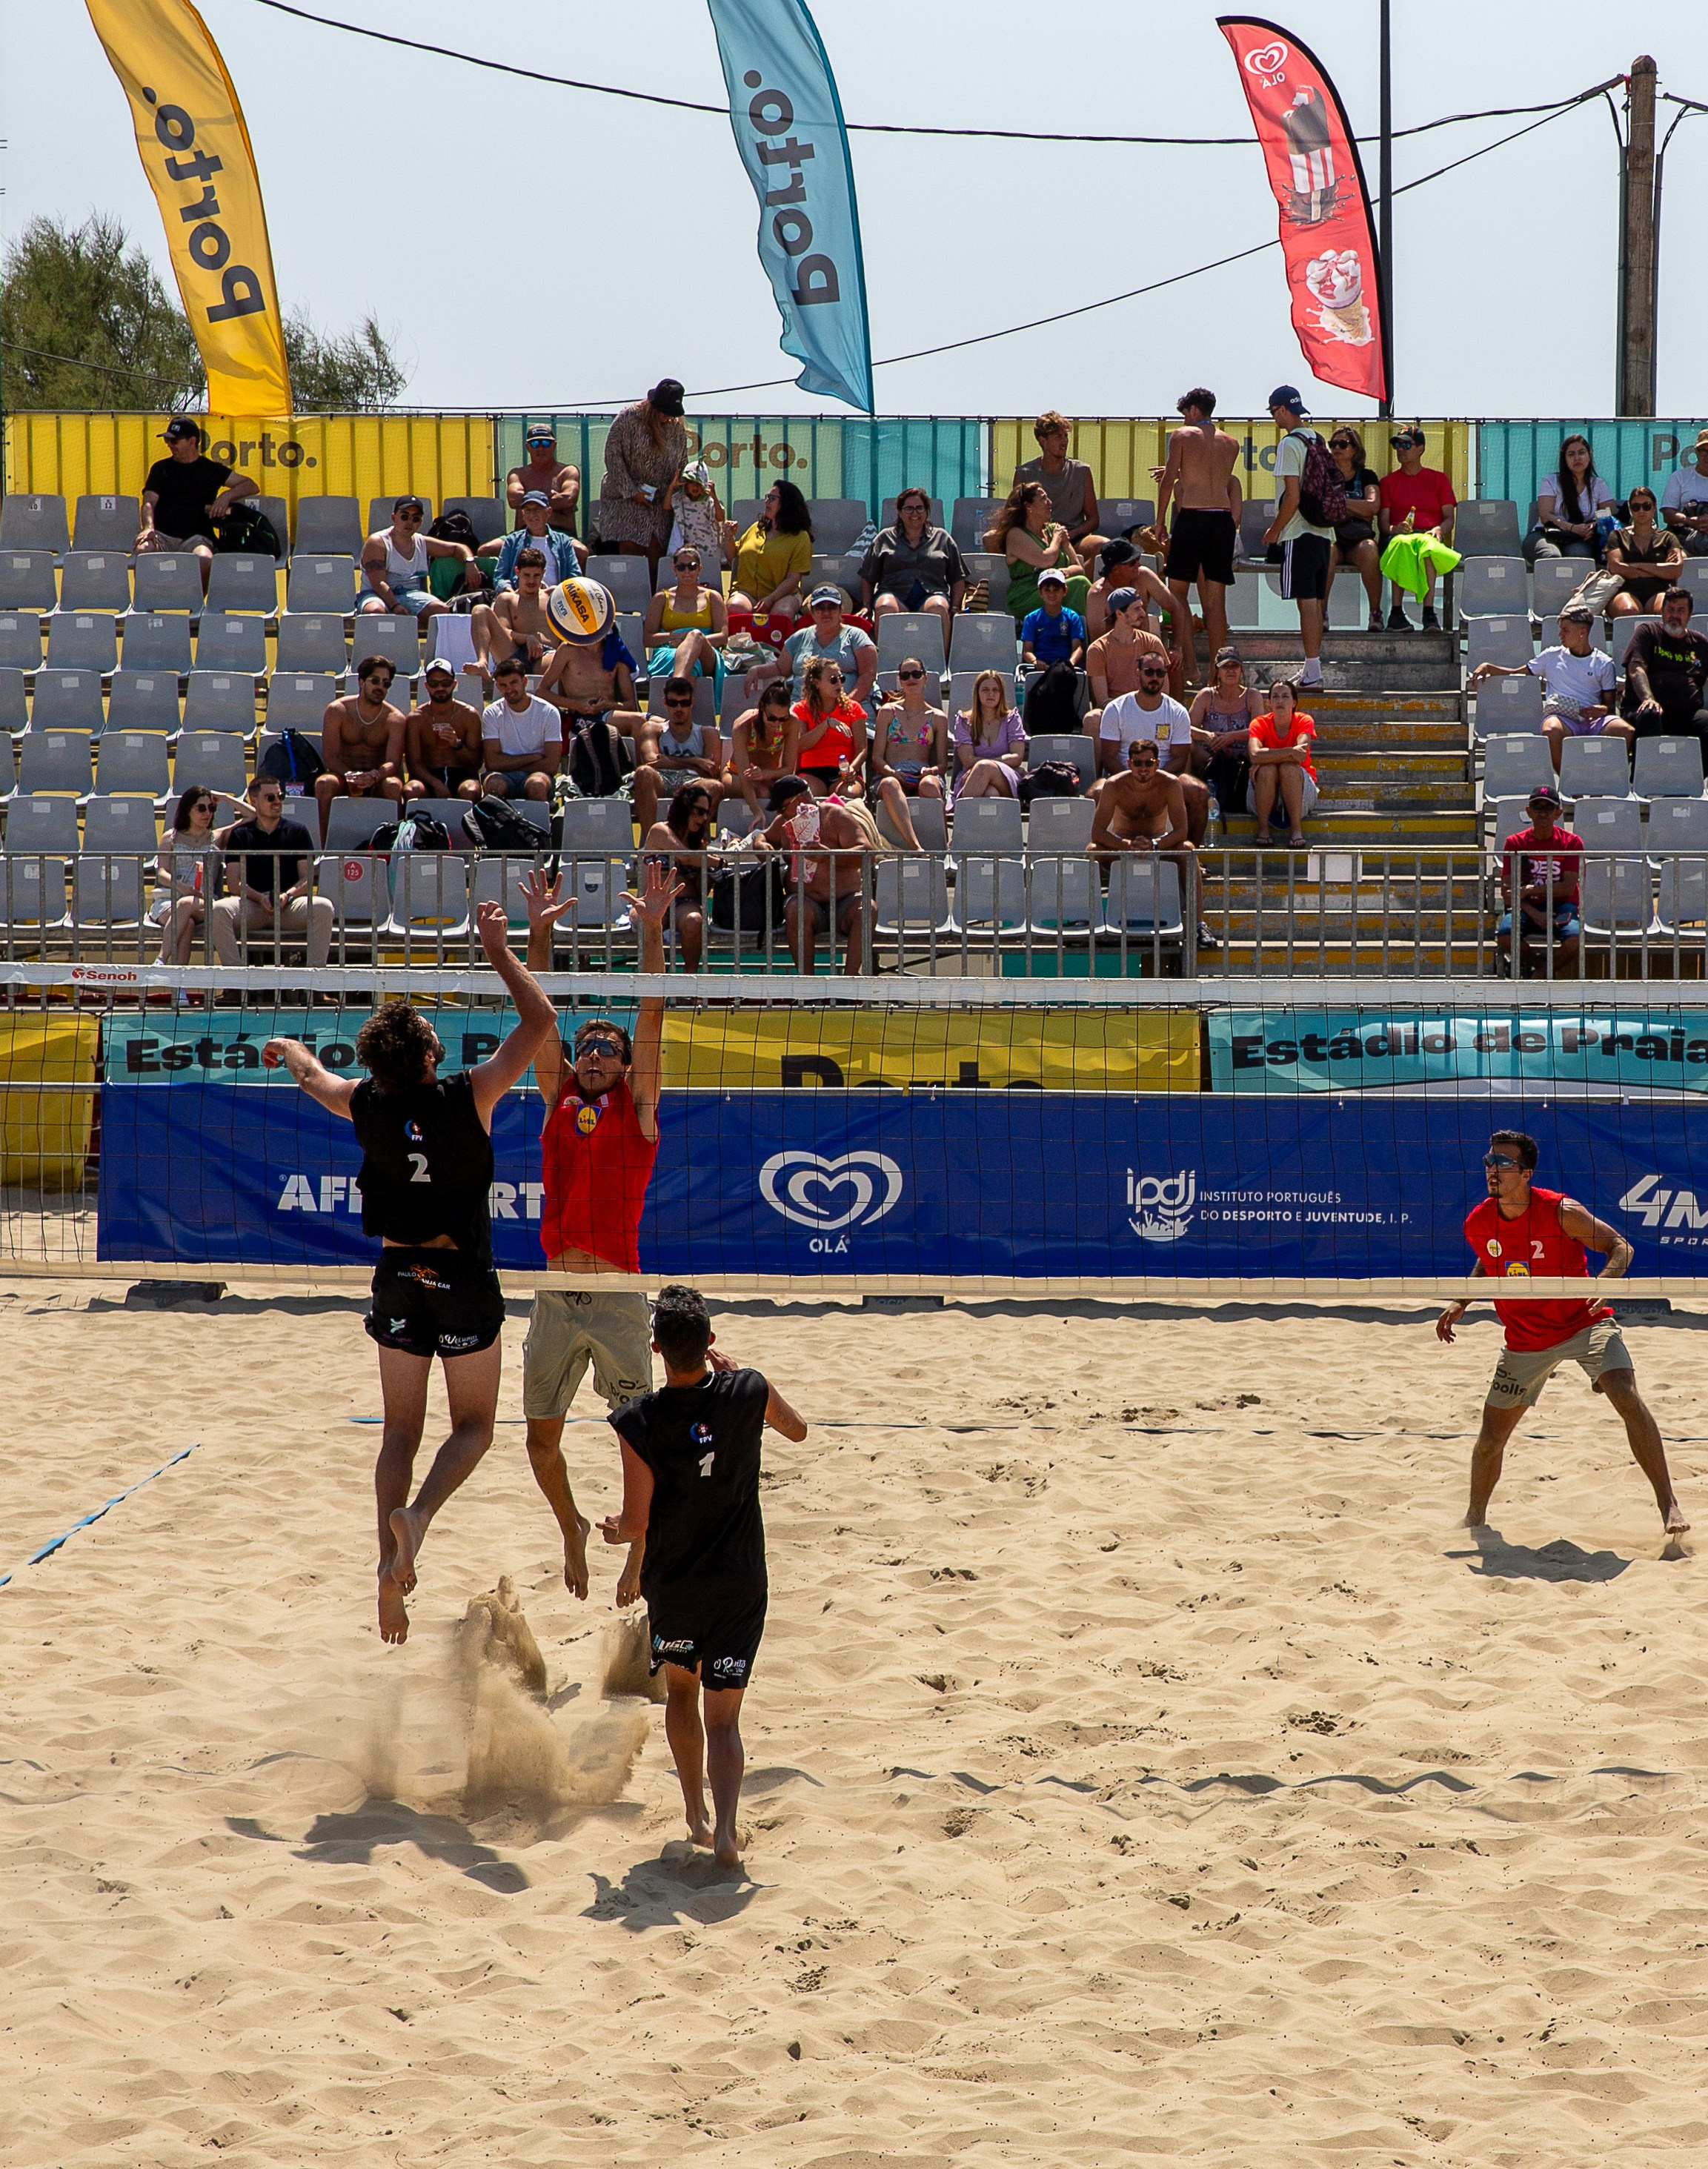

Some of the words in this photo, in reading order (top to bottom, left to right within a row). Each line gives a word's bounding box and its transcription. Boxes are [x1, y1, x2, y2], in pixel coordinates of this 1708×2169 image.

[86, 971, 137, 980] Senoh
[1232, 1028, 1456, 1069] Estádio
[1473, 1026, 1547, 1054] de
[408, 1153, 431, 1182] 2
[1200, 1191, 1263, 1203] INSTITUTO
[1266, 1190, 1342, 1204] PORTUGUÊS
[1200, 1210, 1220, 1221] DO
[1222, 1210, 1292, 1221] DESPORTO
[1295, 1212, 1302, 1221] E
[1305, 1211, 1386, 1224] JUVENTUDE,
[809, 1235, 848, 1253] OLÁ
[1530, 1240, 1545, 1259] 2
[437, 1282, 451, 1290] CAR
[699, 1435, 713, 1444] FPV
[698, 1451, 715, 1478] 1
